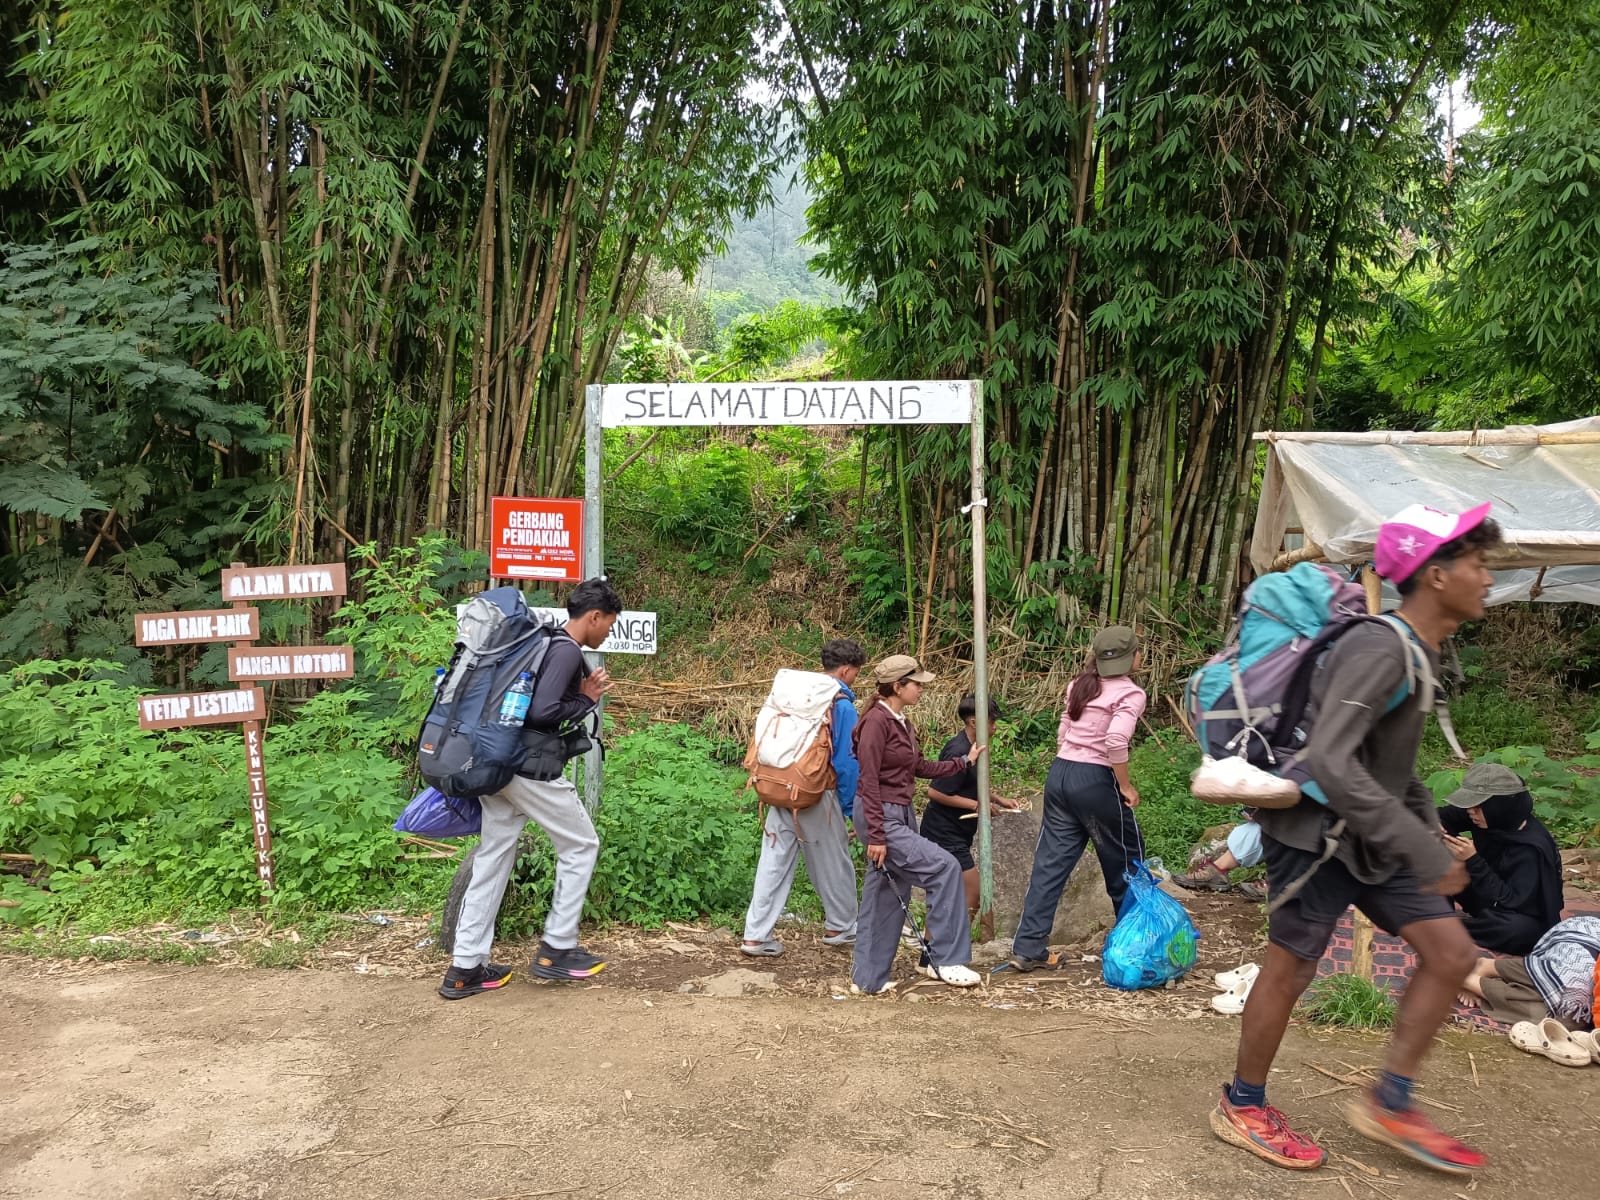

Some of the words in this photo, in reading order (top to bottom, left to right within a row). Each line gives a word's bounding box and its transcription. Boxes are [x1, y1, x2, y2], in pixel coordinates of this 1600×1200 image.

[625, 387, 776, 419] SELAMAT
[508, 511, 564, 530] GERBANG
[502, 528, 570, 548] PENDAKIAN
[229, 573, 284, 597] ALAM
[288, 571, 334, 594] KITA
[142, 618, 177, 642] JAGA
[178, 613, 251, 639] BAIK-BAIK
[608, 619, 655, 642] ANGGI
[235, 655, 291, 676] JANGAN
[293, 652, 347, 674] KOTORI
[192, 689, 255, 717] LESTARI
